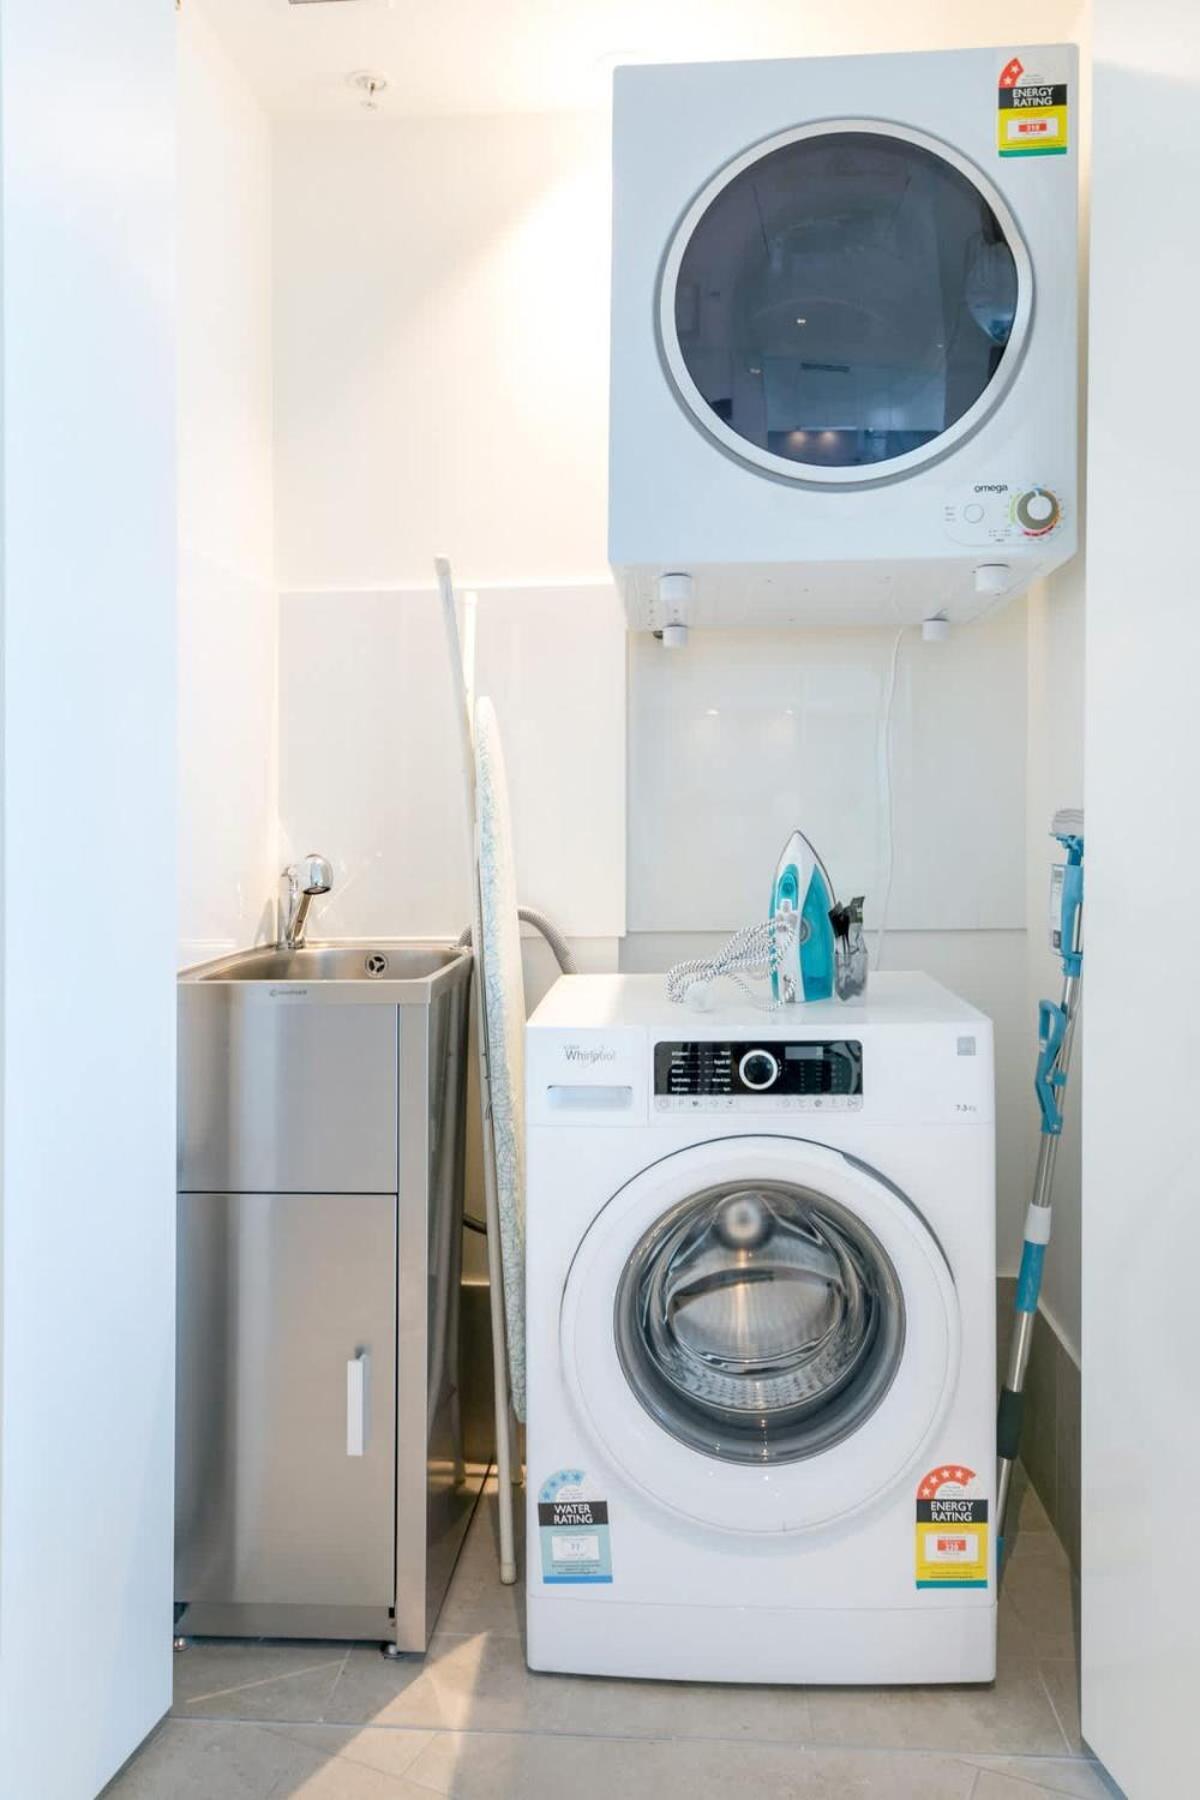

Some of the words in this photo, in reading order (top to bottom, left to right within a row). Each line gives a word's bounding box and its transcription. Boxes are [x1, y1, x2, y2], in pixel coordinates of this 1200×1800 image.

[1012, 87, 1053, 98] ENERGY
[1013, 97, 1052, 107] RATING
[974, 484, 1008, 493] omega
[553, 1504, 591, 1514] WATER
[930, 1502, 973, 1512] ENERGY
[553, 1514, 593, 1525] RATING
[931, 1512, 972, 1522] RATING
